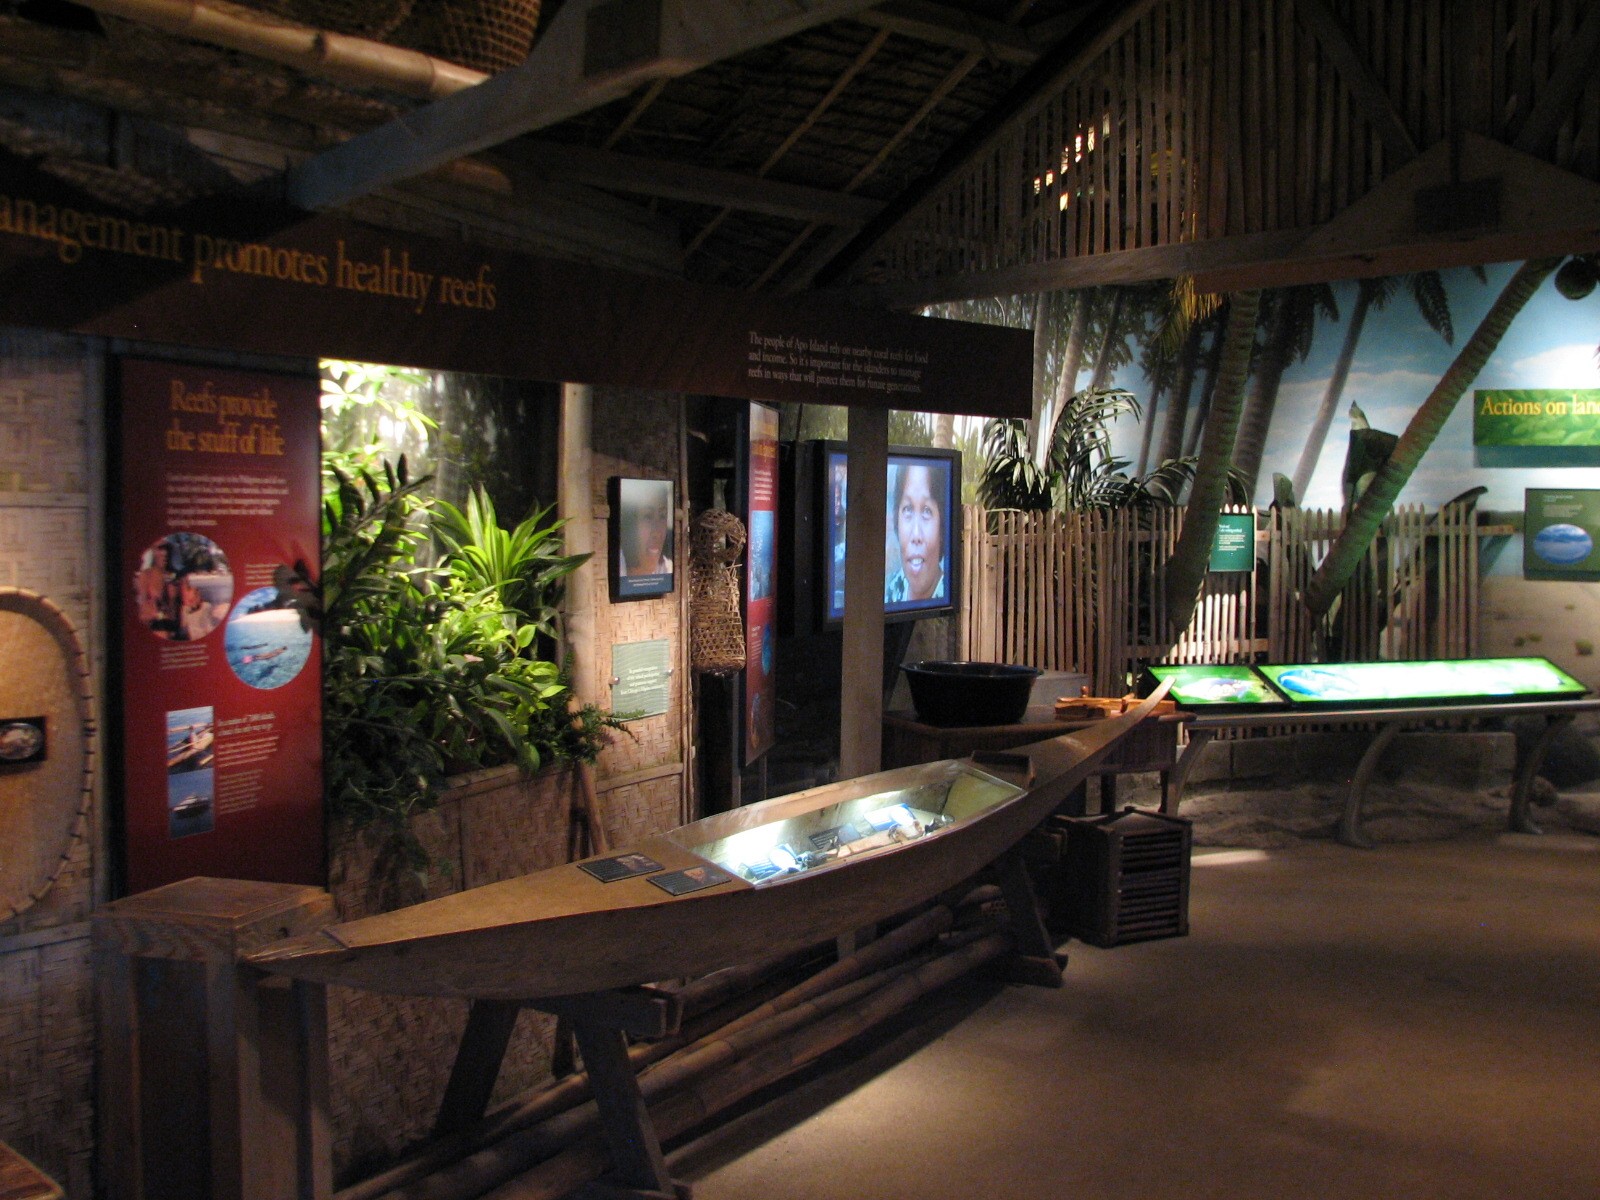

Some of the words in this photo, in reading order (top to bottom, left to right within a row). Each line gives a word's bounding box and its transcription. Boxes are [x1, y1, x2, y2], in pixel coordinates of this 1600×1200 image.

[191, 234, 329, 286] promotes
[336, 239, 434, 314] healthy
[440, 263, 497, 310] reefs
[749, 331, 763, 345] The
[764, 334, 784, 352] people
[786, 336, 794, 348] of
[809, 339, 828, 352] Island
[748, 349, 761, 362] and
[789, 353, 797, 365] So
[809, 356, 841, 372] important
[772, 371, 788, 383] ways
[1481, 396, 1542, 416] Actions
[1546, 401, 1567, 415] on
[166, 417, 195, 451] the
